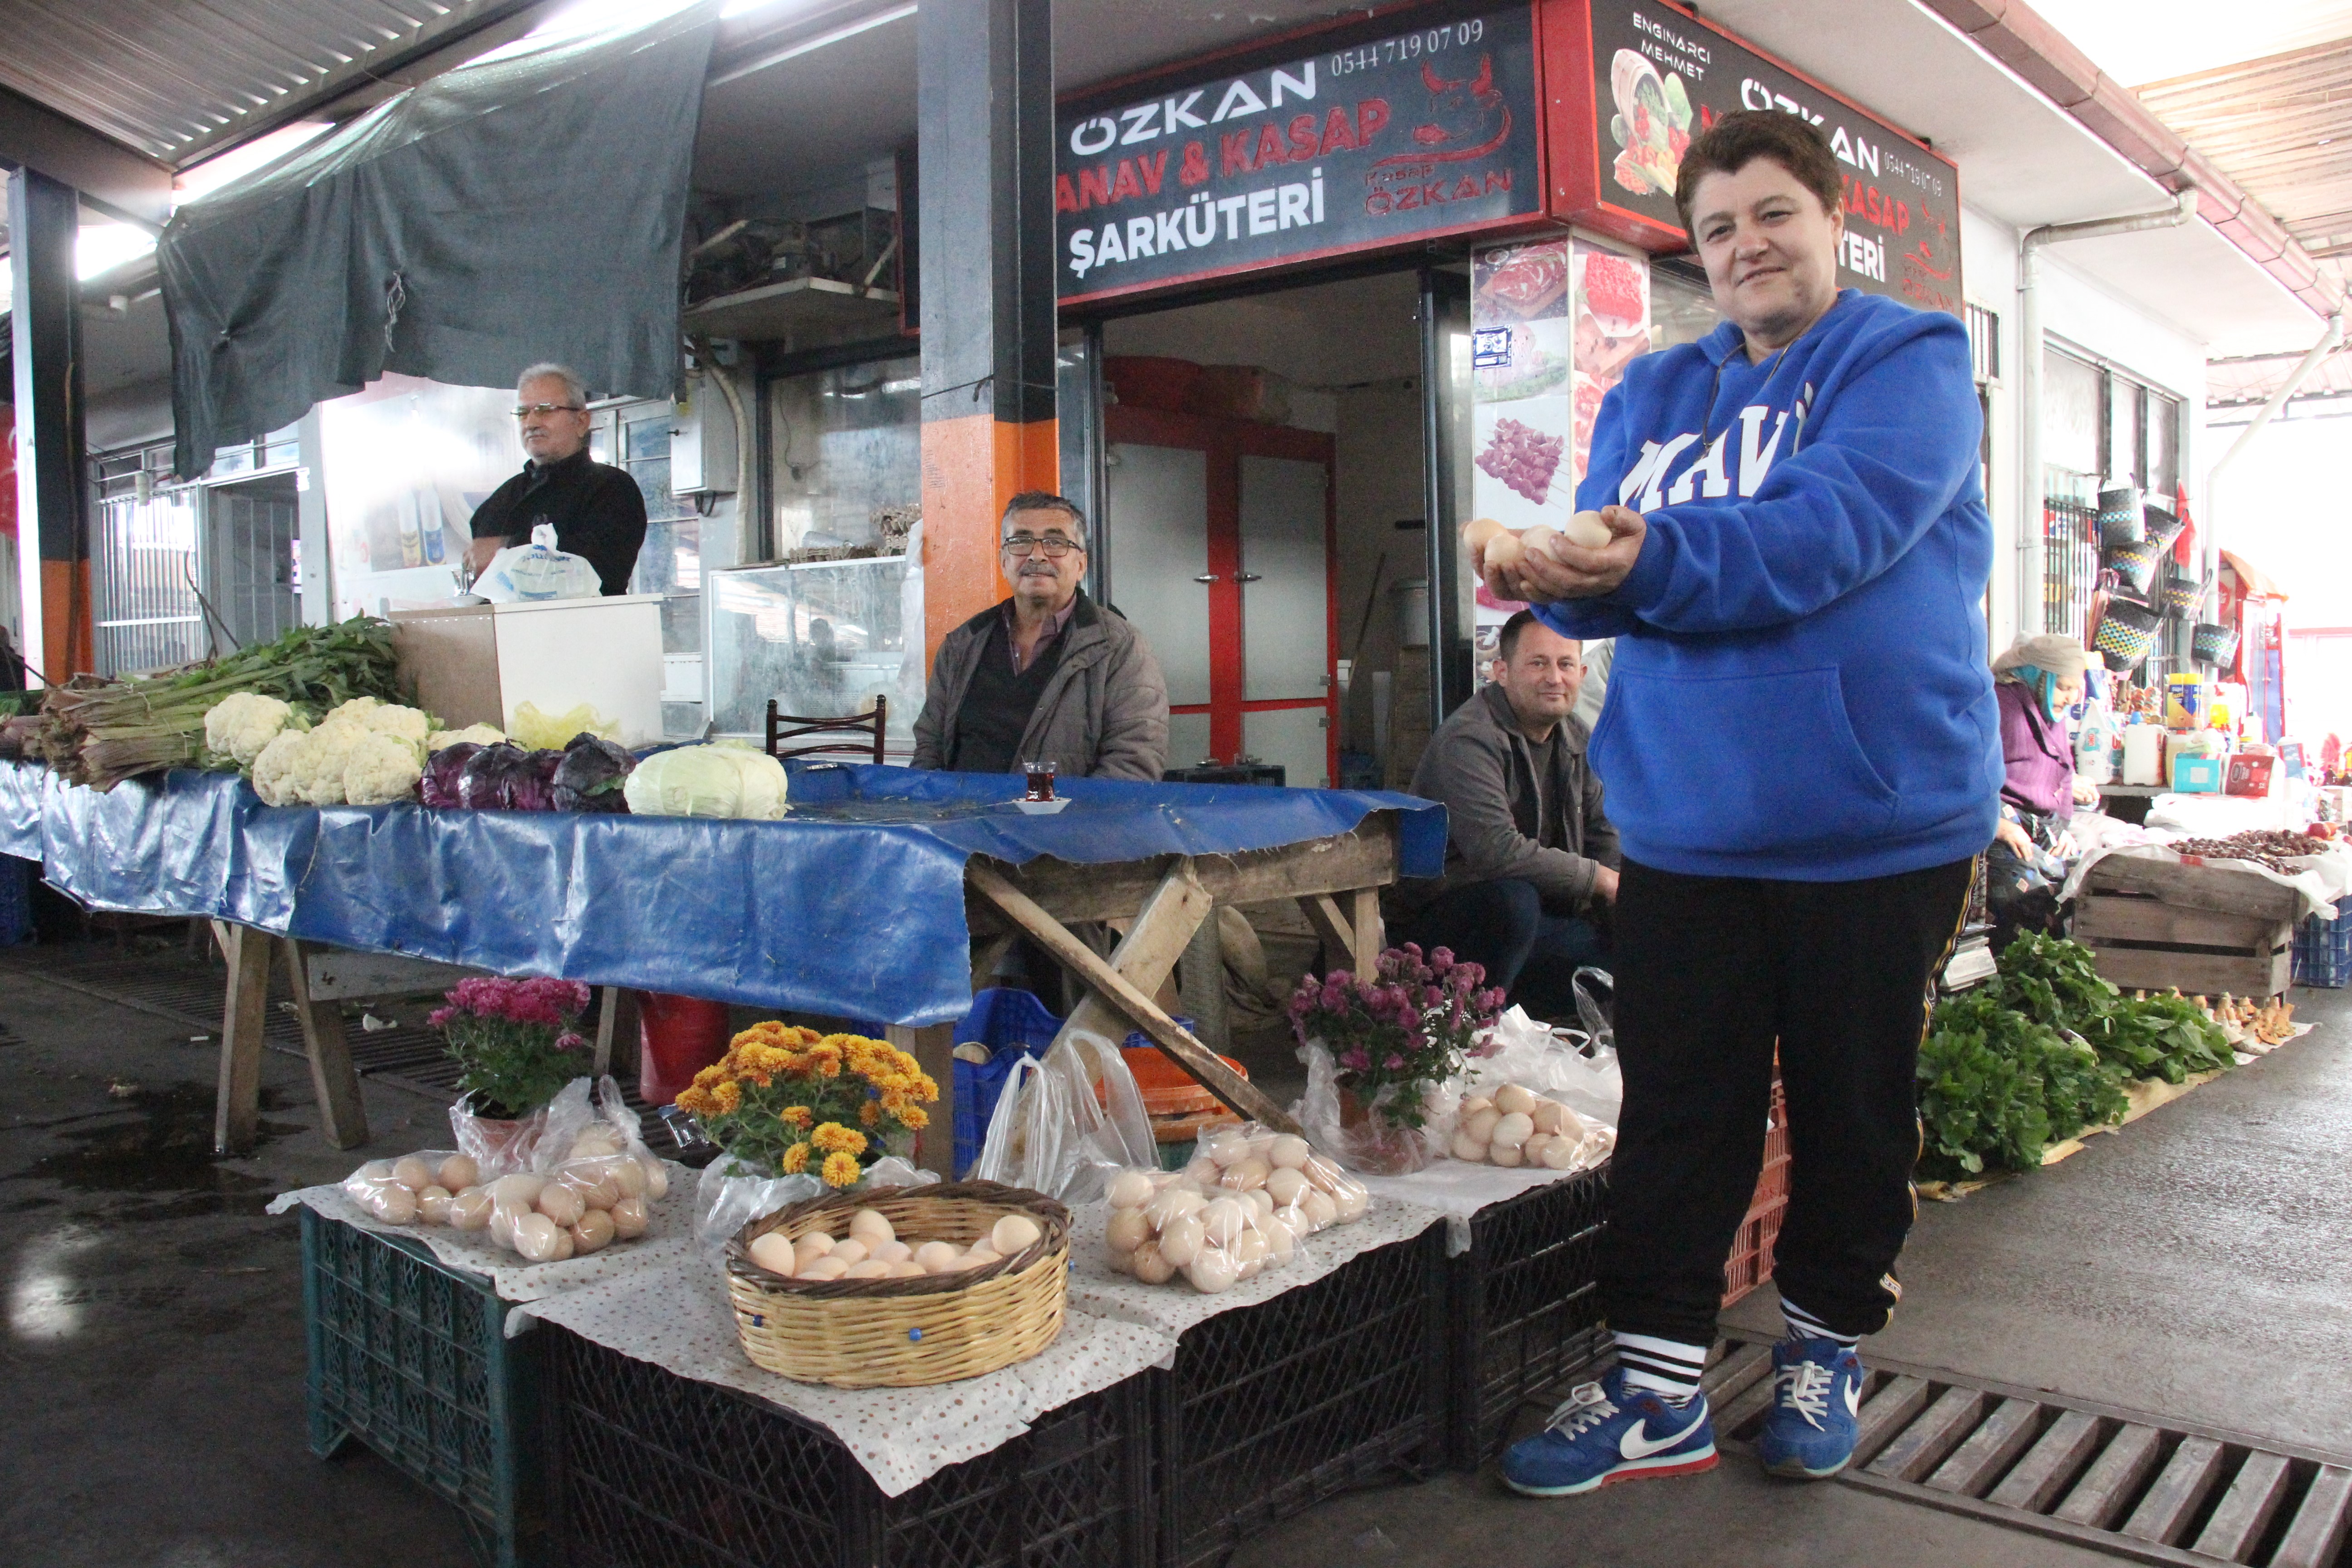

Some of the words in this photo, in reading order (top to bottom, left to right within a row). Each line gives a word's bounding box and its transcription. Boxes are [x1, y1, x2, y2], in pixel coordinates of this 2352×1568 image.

[1331, 46, 1379, 76] 0544
[1386, 34, 1421, 63] 719
[1427, 26, 1451, 53] 07
[1458, 19, 1483, 45] 09
[1633, 11, 1711, 64] ENGINARCI
[1641, 39, 1705, 81] MEHMET
[1071, 61, 1316, 156] ÖZKAN
[1055, 149, 1168, 215] ANAV
[1180, 141, 1210, 186] &
[1220, 98, 1390, 177] KASAP
[1365, 167, 1514, 216] ÖZKAN
[1069, 167, 1325, 279] ŞARKÜTERİ
